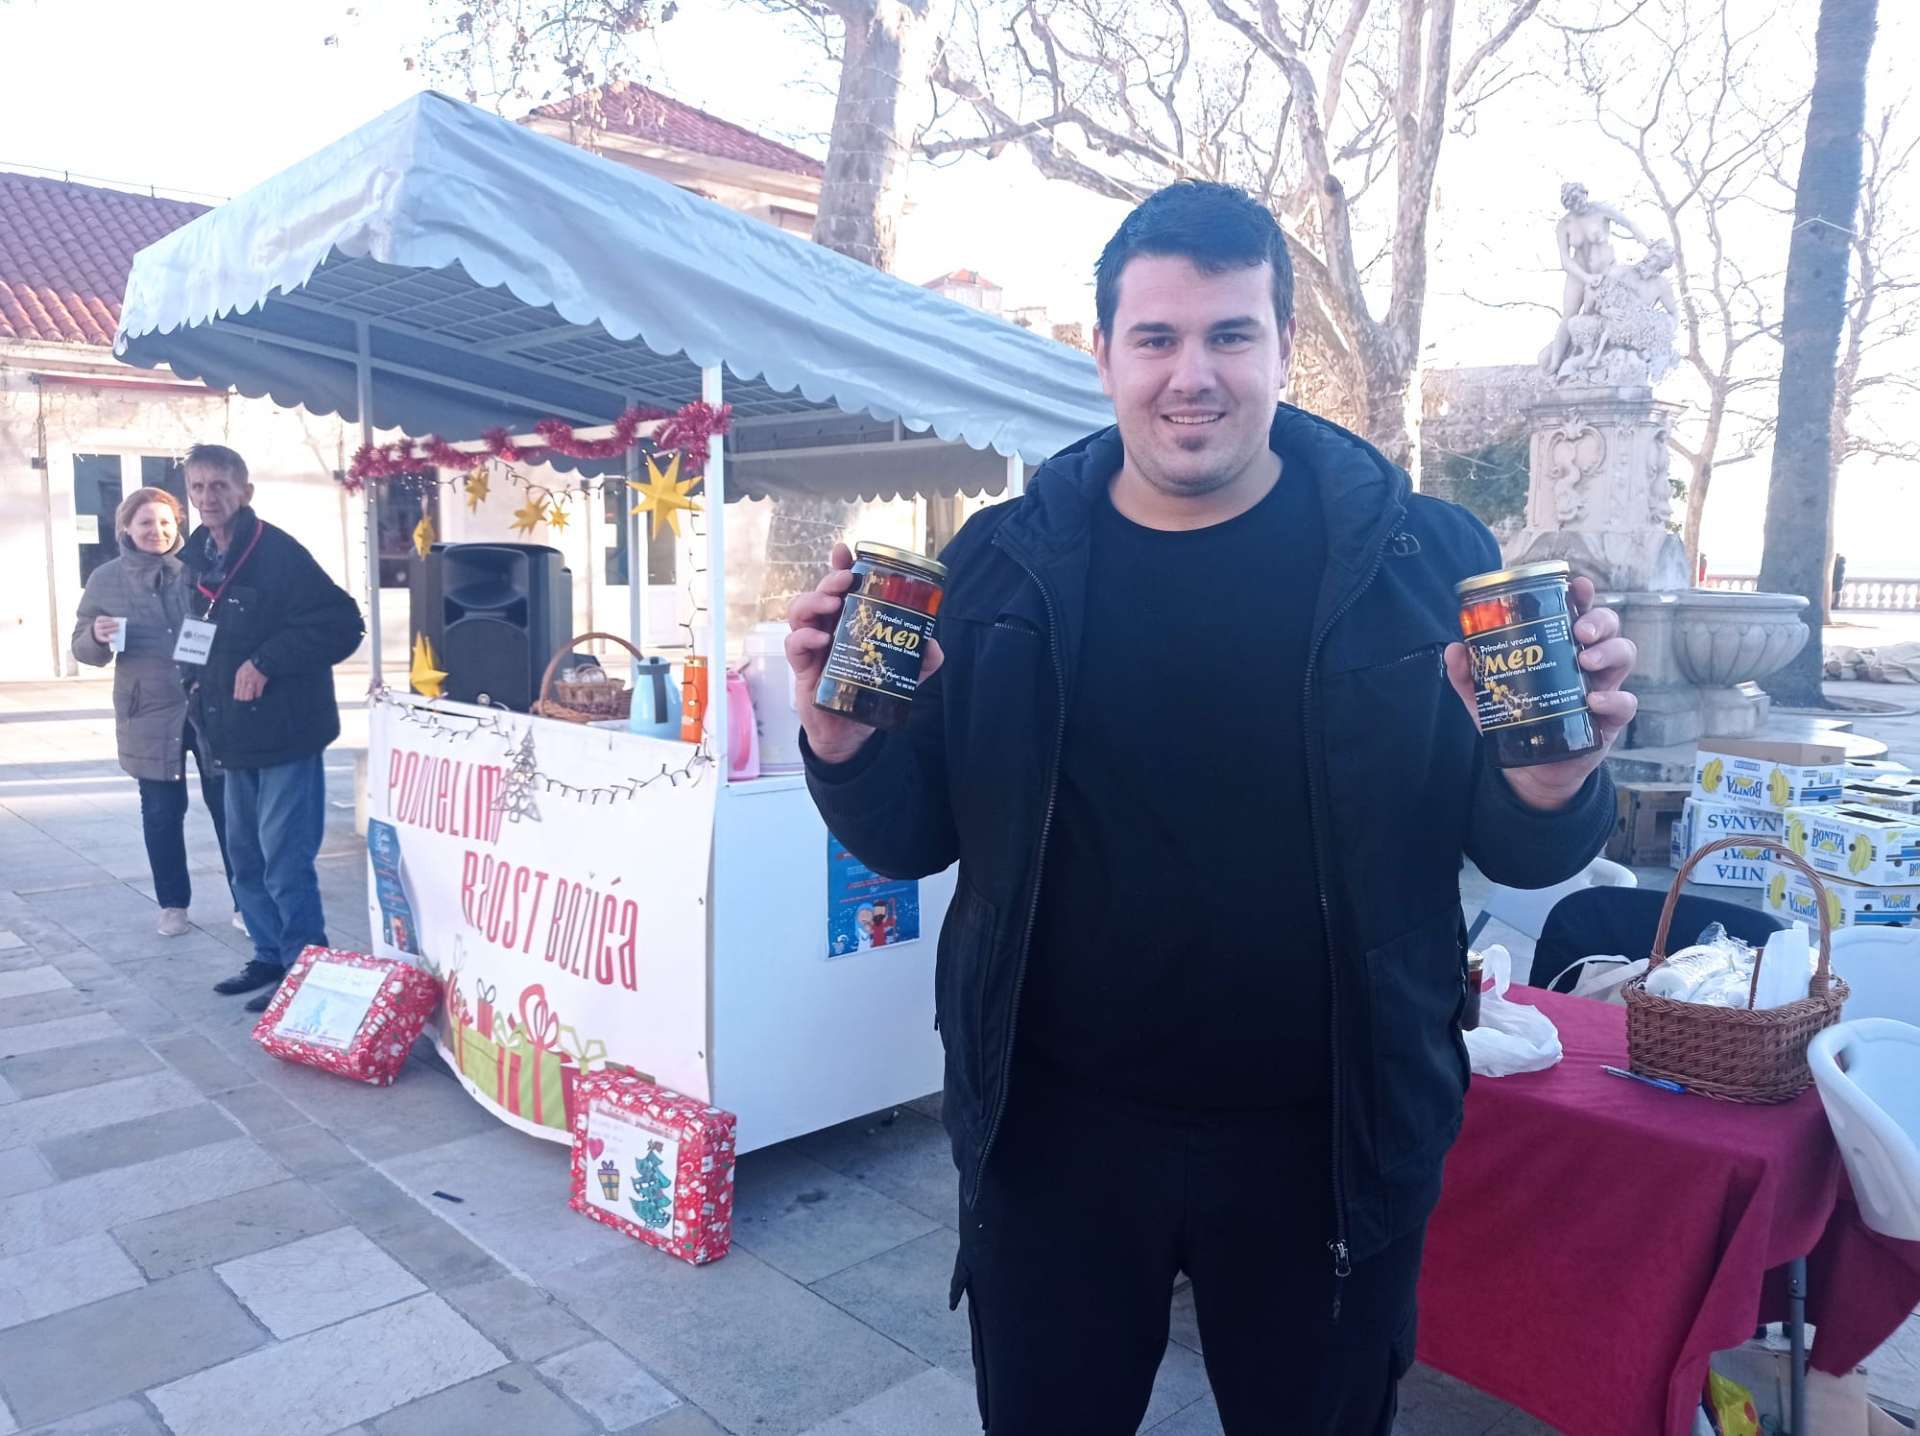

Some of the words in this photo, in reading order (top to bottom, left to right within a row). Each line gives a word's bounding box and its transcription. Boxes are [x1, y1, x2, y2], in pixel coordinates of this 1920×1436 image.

[868, 622, 920, 650] MED
[1480, 640, 1508, 653] Prirodni
[1510, 634, 1537, 647] vrcani
[1484, 645, 1544, 677] MED
[1726, 775, 1763, 799] BONITA
[1707, 814, 1777, 832] NANAS
[1811, 827, 1845, 855] BONITA
